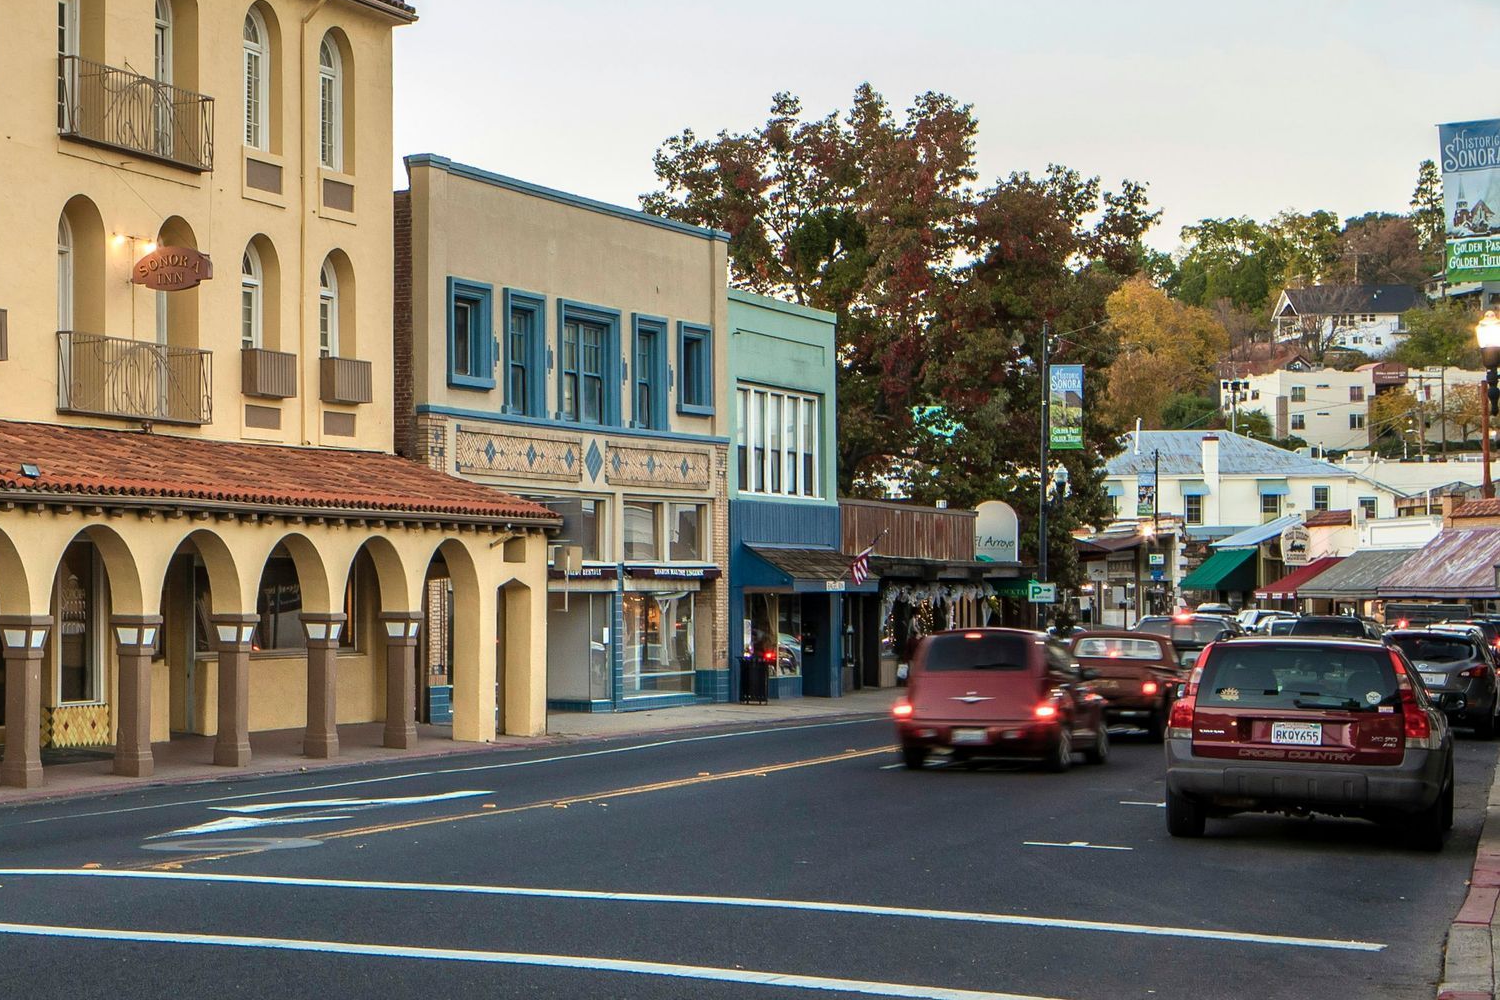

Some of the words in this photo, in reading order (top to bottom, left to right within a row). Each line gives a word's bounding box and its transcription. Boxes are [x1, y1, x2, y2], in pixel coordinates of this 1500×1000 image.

[1453, 130, 1500, 151] HISTORIC
[1453, 241, 1483, 256] GOLDEN
[139, 254, 200, 278] SONORA
[1449, 255, 1479, 269] GOLDEN
[156, 271, 184, 286] INN
[1051, 375, 1082, 391] SONORA
[984, 535, 1015, 548] Arroyo
[1031, 586, 1042, 599] P
[1238, 749, 1285, 759] CROSS
[1288, 750, 1357, 762] COUNTRY
